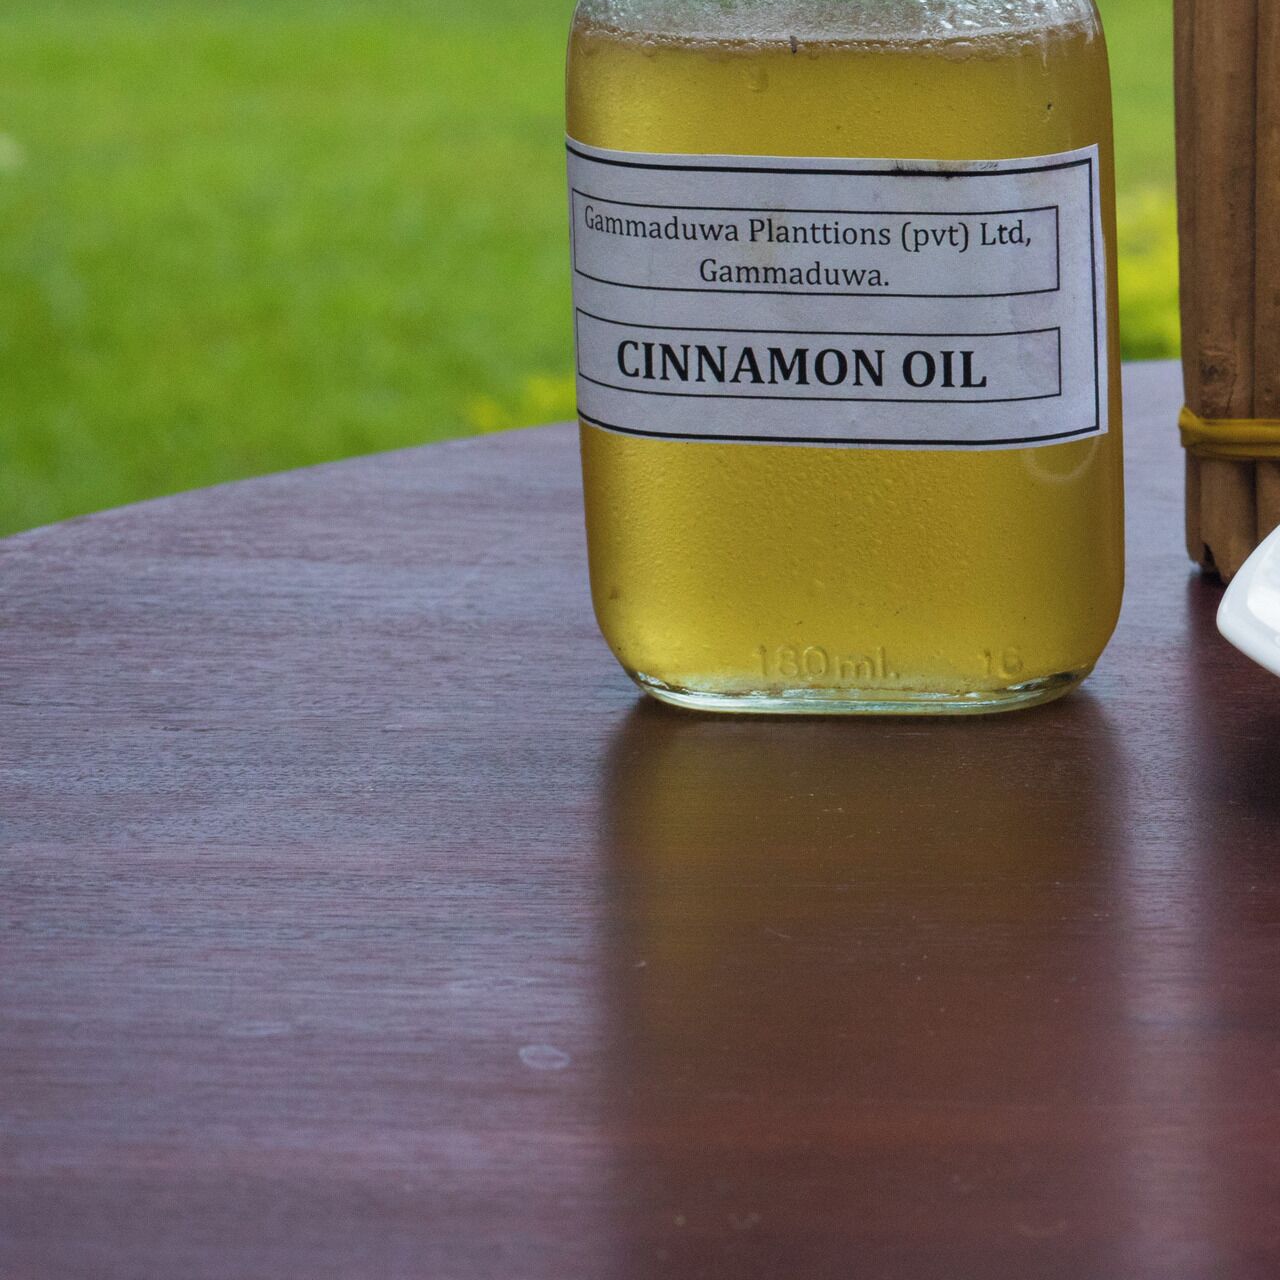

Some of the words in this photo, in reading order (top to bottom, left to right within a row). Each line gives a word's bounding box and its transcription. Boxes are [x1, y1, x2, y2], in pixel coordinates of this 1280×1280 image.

[585, 205, 739, 241] Gammaduwa
[749, 218, 891, 246] Planttions
[902, 222, 969, 253] (pvt)
[980, 220, 1031, 247] Ltd,
[700, 259, 889, 287] Gammaduwa.
[617, 340, 885, 386] CINNAMON
[902, 351, 987, 388] OIL
